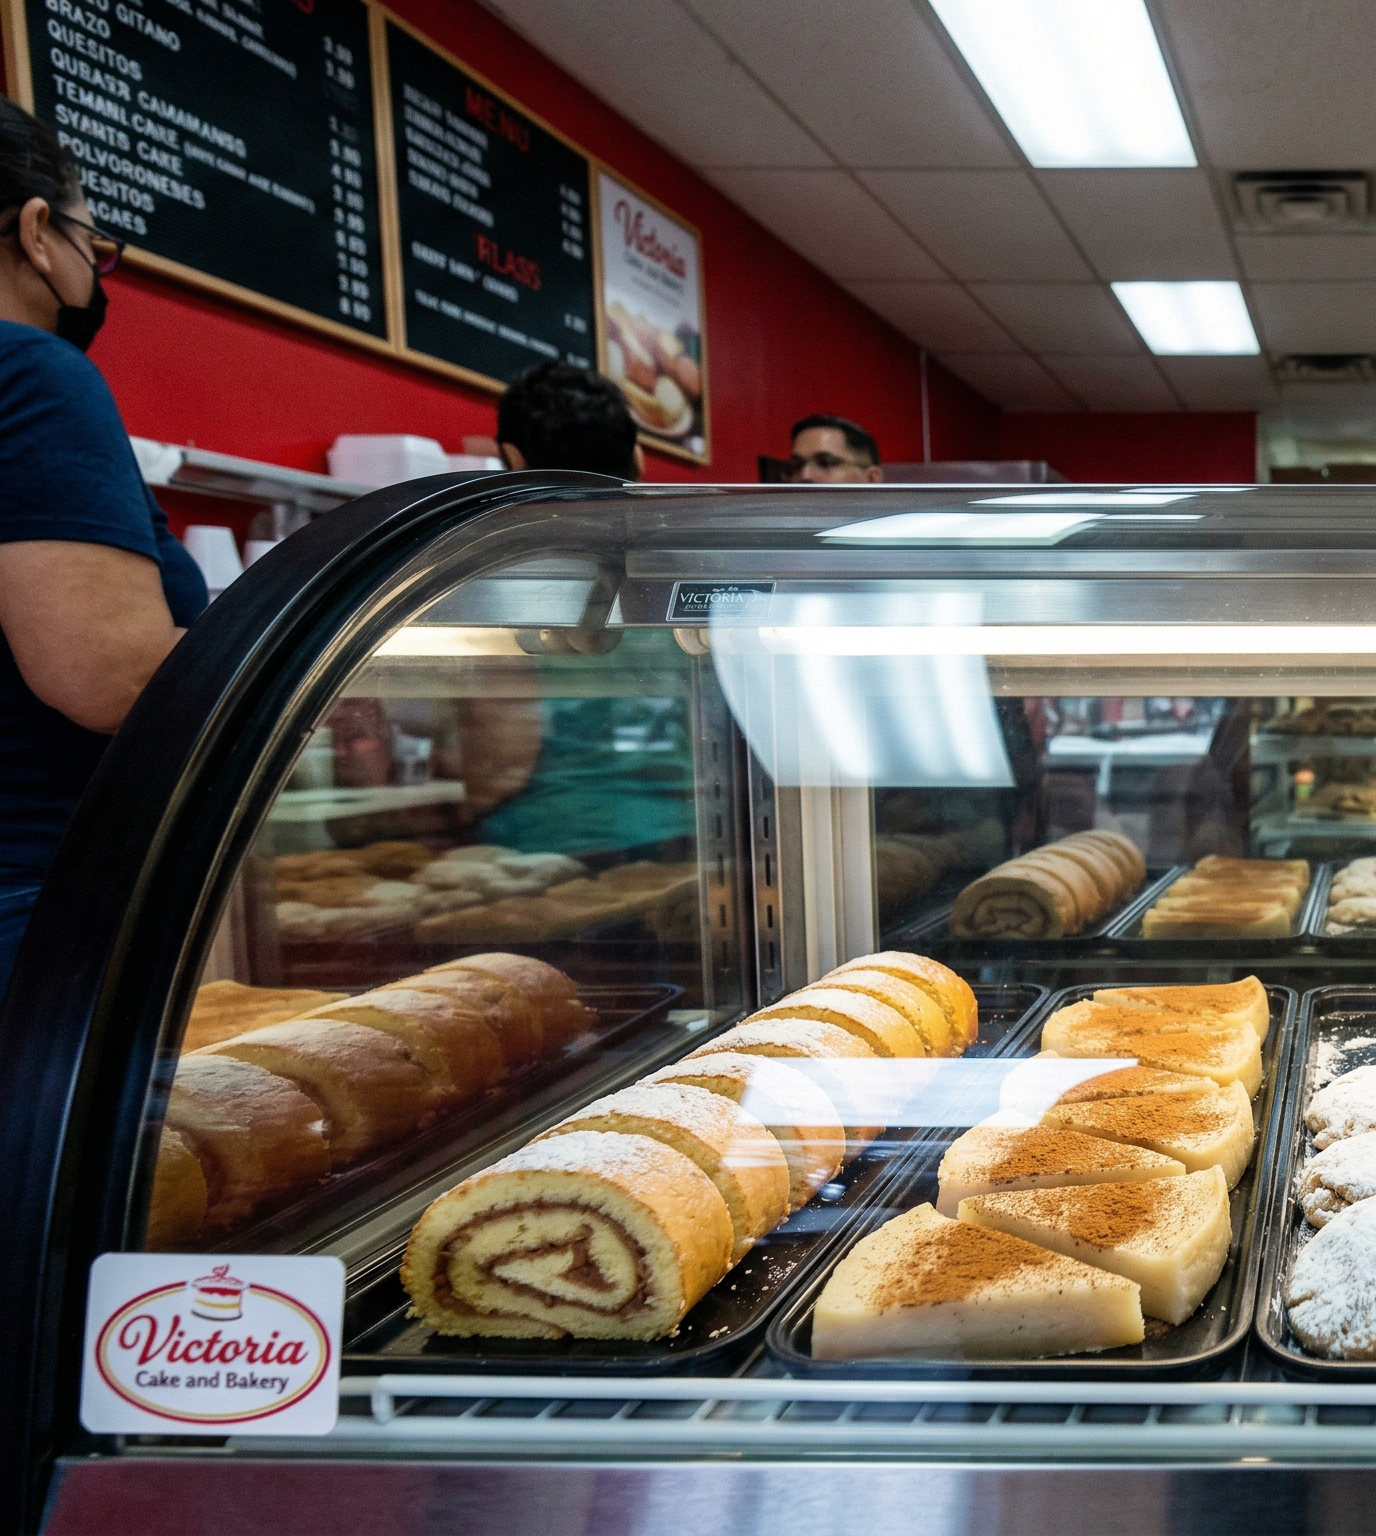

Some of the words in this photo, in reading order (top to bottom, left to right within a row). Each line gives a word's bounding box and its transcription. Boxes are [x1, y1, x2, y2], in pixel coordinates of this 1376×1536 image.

[47, 18, 142, 82] QUESITOS
[115, 2, 181, 52] GITANO
[78, 166, 155, 213] UESITOS
[680, 592, 744, 603] VICTORIA
[119, 1314, 309, 1366] Victoria
[135, 1370, 181, 1388] Cake
[185, 1371, 221, 1389] and
[225, 1371, 290, 1395] Bakery
